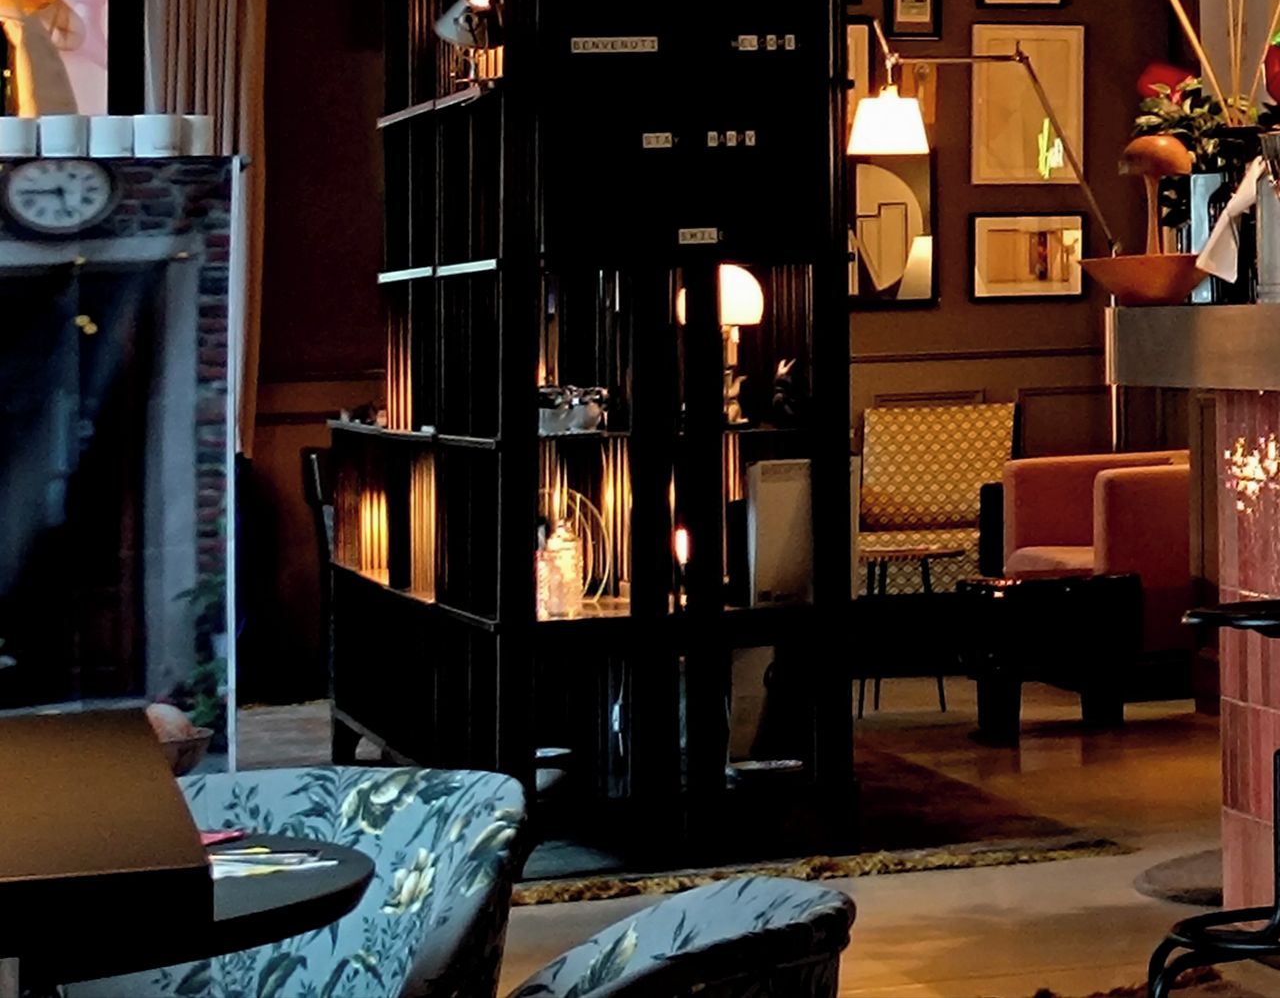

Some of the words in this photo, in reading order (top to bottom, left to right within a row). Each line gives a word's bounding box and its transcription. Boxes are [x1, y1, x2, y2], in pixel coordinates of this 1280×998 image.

[572, 38, 657, 51] BENVENUTI
[644, 133, 680, 147] STAY
[708, 132, 755, 145] HAPPY
